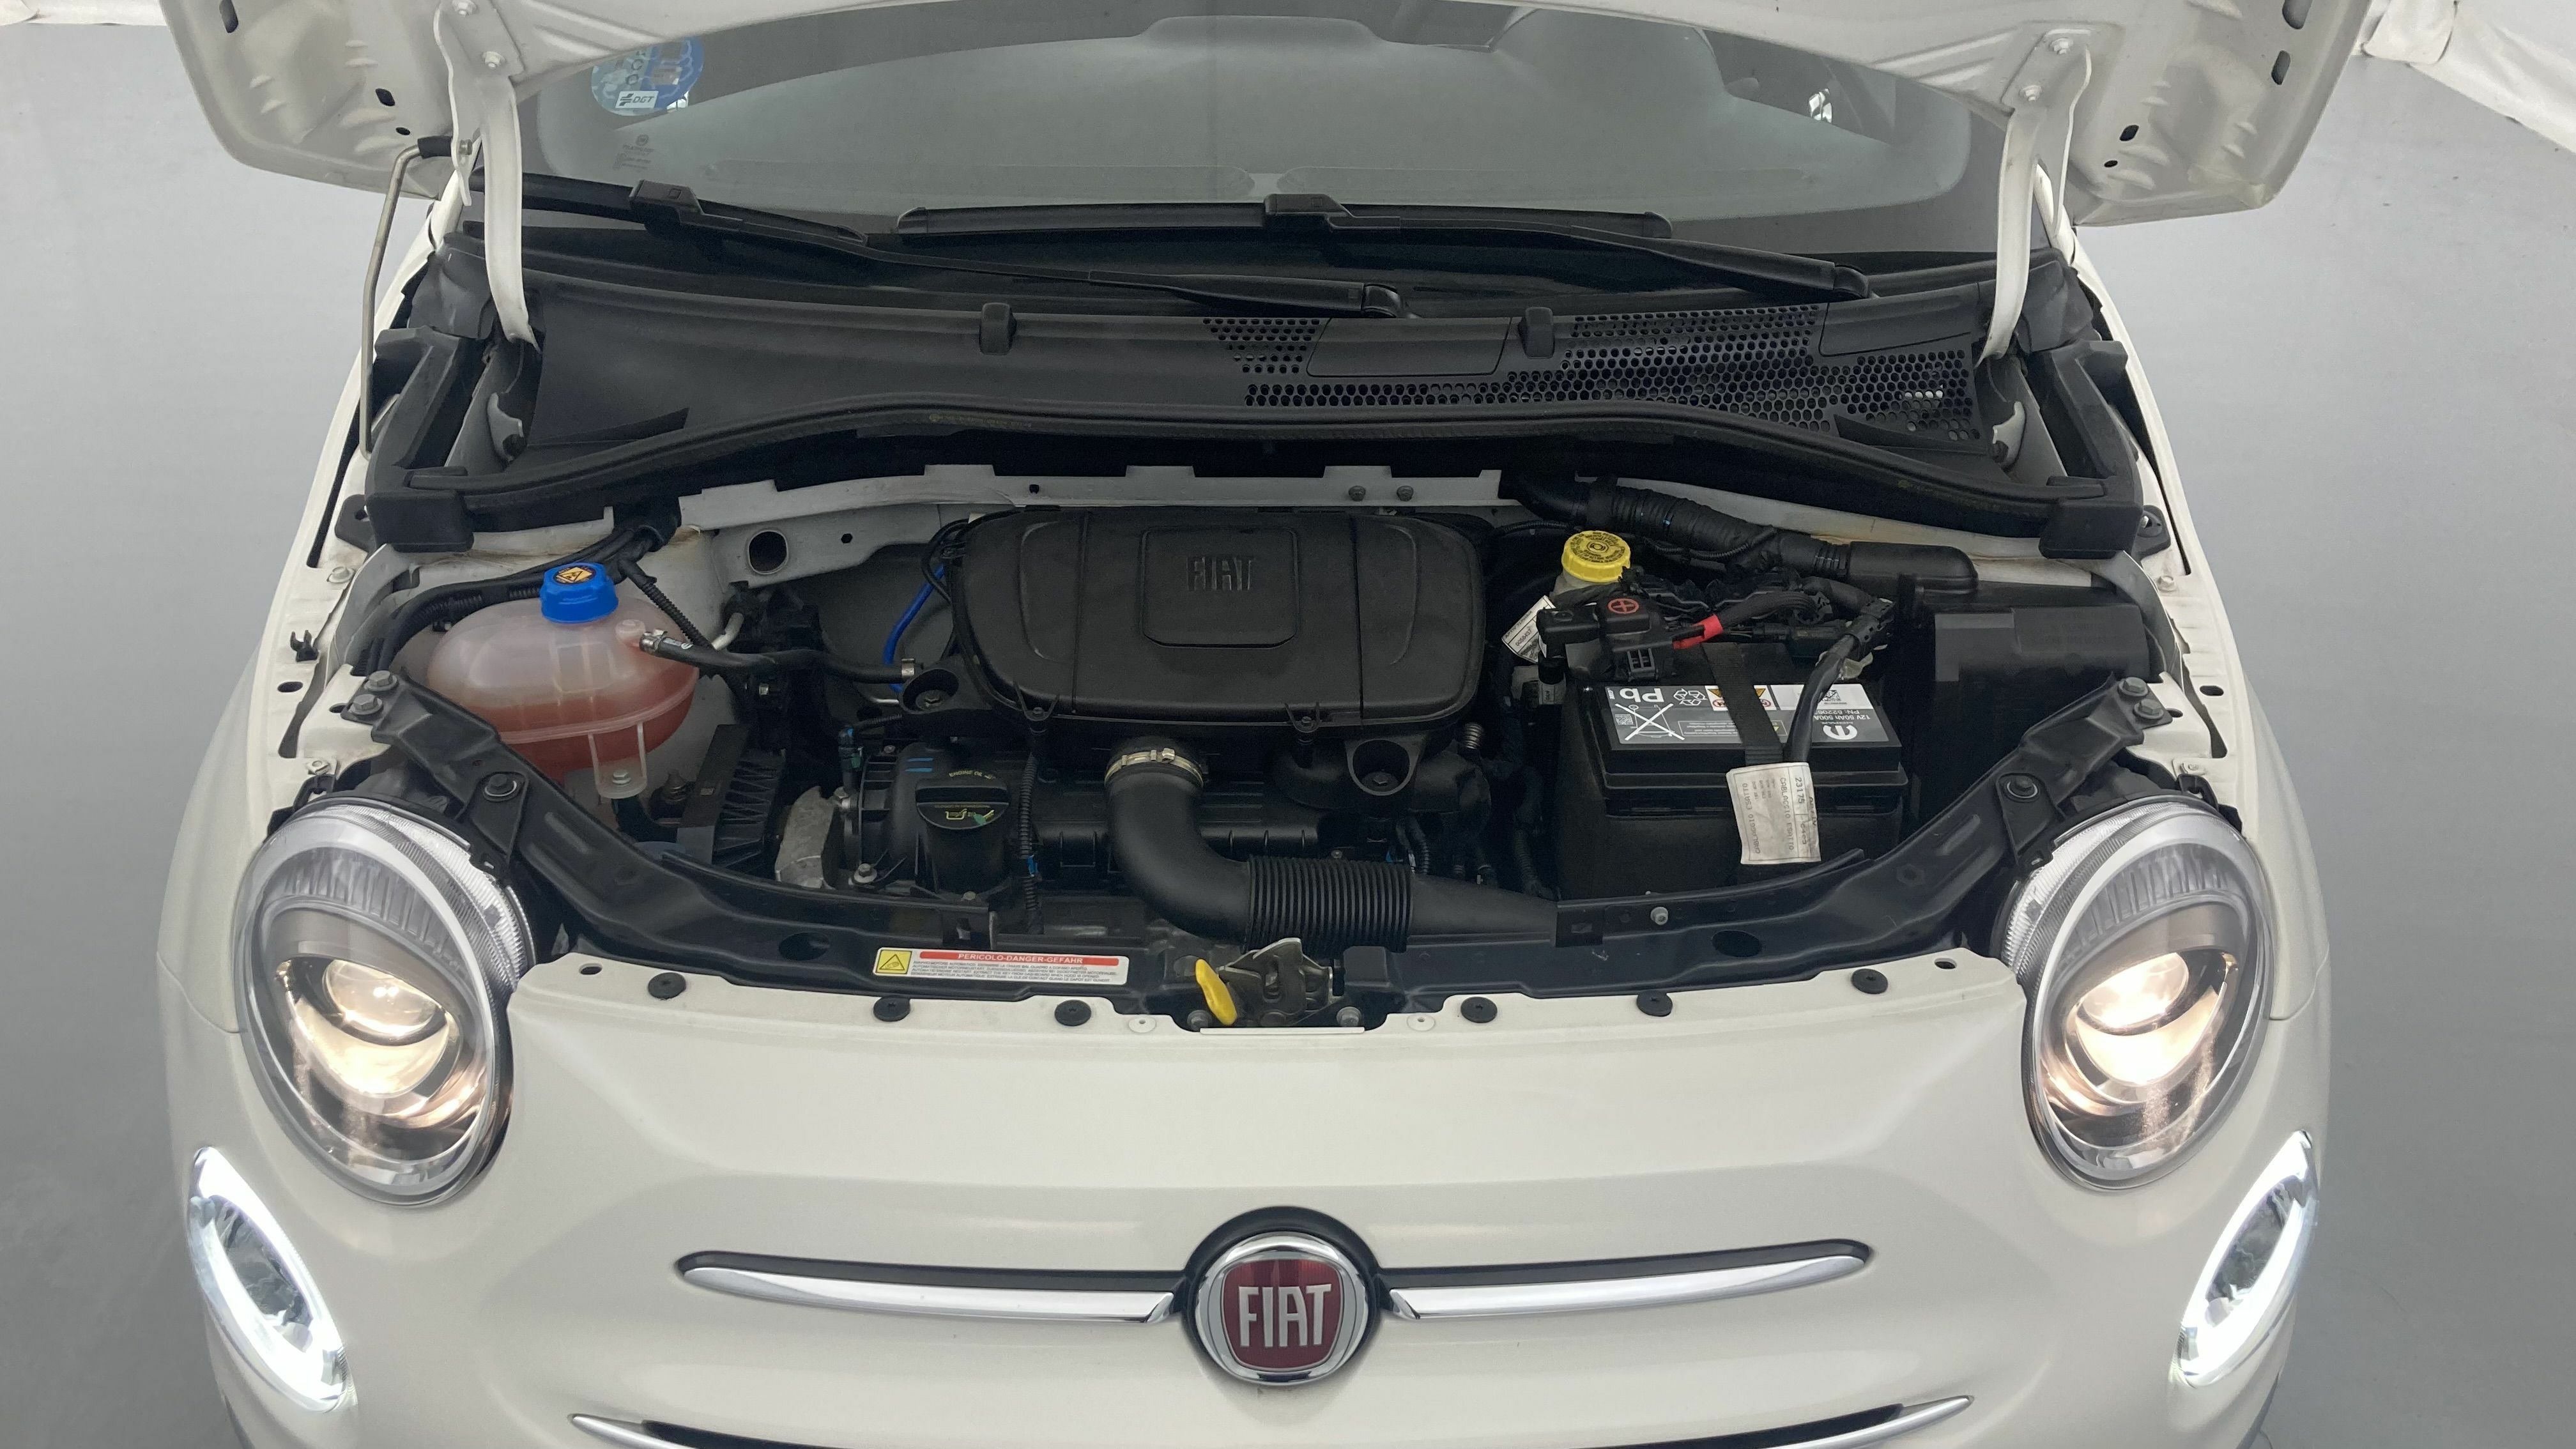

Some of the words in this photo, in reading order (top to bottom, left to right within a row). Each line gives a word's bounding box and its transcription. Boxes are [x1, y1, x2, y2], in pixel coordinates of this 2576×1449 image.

[1185, 556, 1255, 592] FIAT
[1618, 687, 1665, 703] Pb
[1742, 783, 1754, 809] ESATTO
[1795, 776, 1805, 804] 23175
[1786, 822, 1794, 850] ESATTO
[957, 953, 1083, 964] PERICOLO-DANGER-GEFAHR
[1238, 1284, 1332, 1348] FIAT
